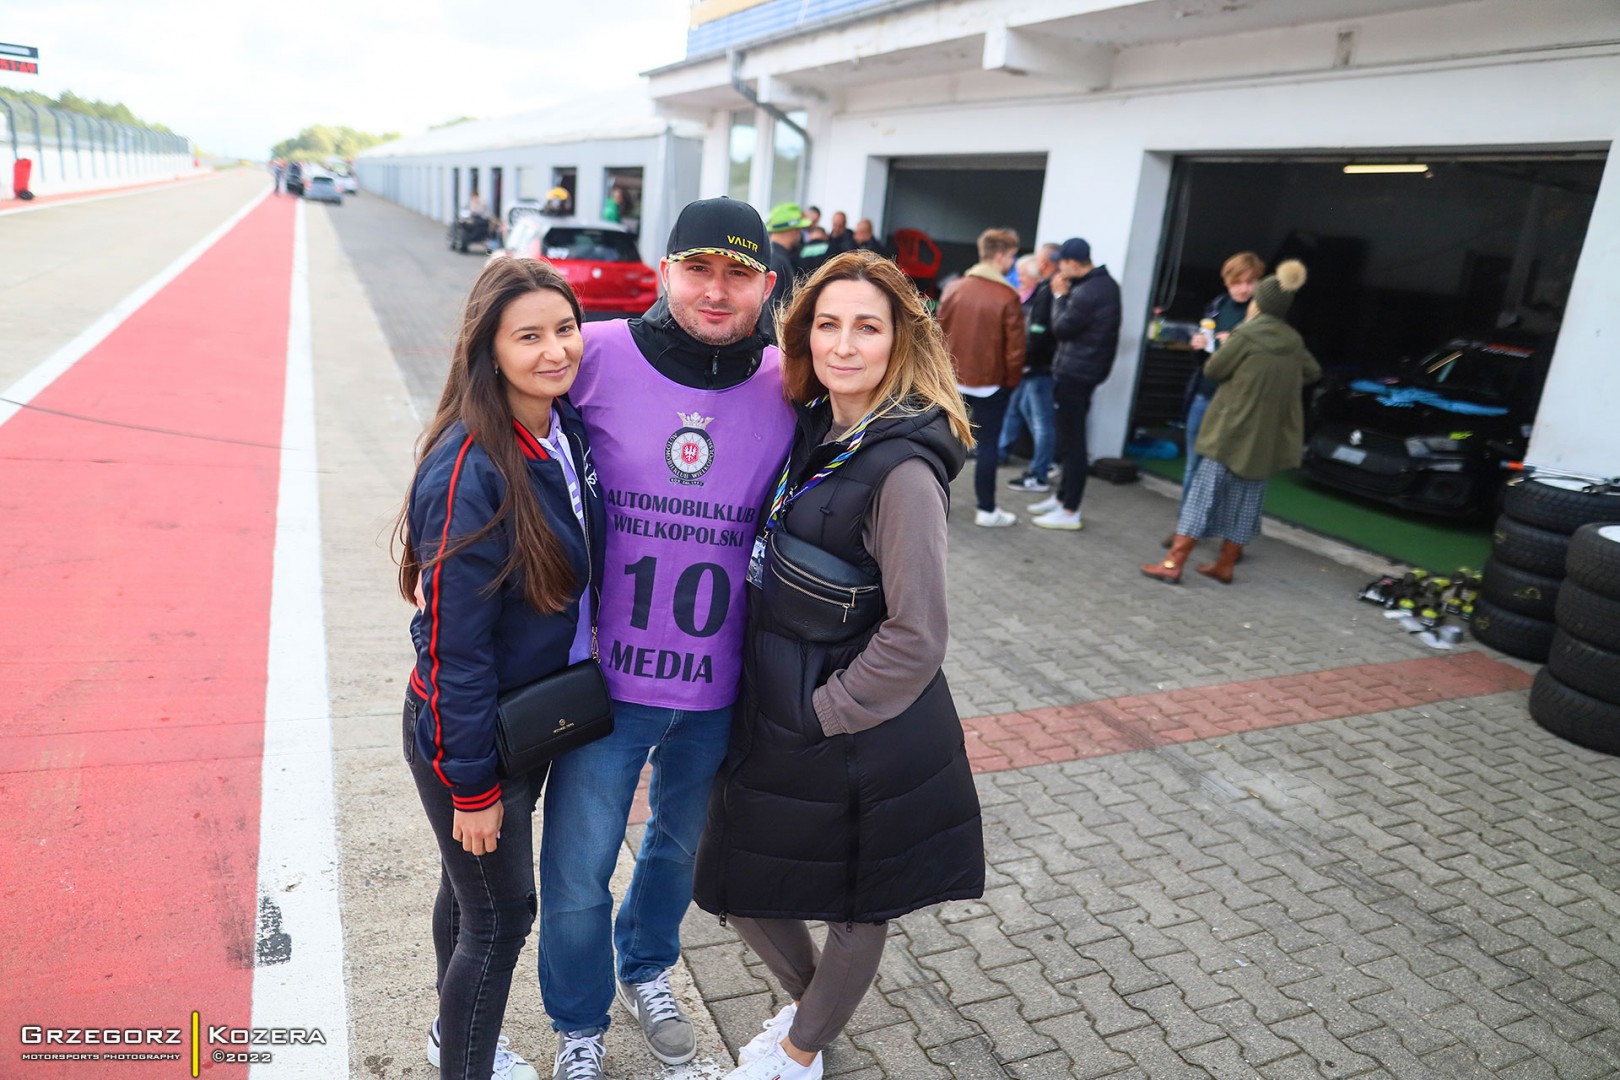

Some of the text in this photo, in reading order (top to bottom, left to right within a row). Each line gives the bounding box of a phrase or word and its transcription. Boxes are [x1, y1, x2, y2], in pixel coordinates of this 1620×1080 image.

[727, 235, 759, 252] VALTR
[608, 489, 756, 524] AUTOMOBILKLUB
[613, 514, 745, 548] WIELKOPOLSKI
[624, 555, 731, 638] 10
[608, 640, 713, 684] MEDIA
